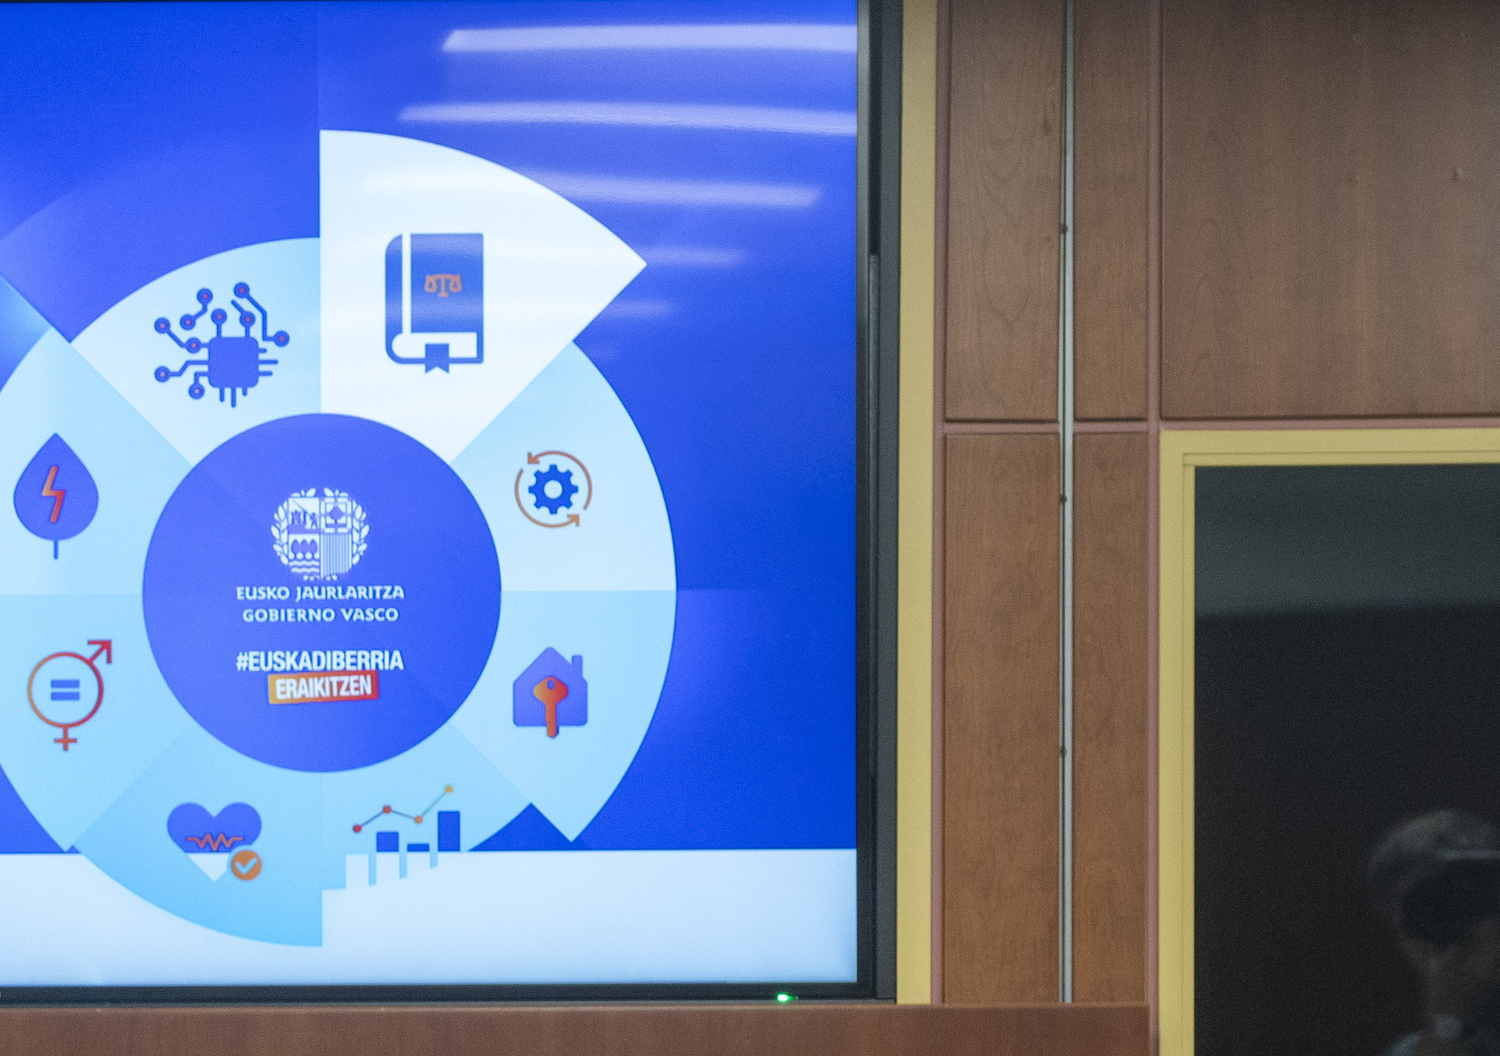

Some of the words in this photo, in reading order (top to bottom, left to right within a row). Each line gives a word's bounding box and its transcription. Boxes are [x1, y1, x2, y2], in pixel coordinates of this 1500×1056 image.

[236, 585, 290, 600] EUSKO
[295, 585, 405, 602] JAURLARITZA
[242, 608, 336, 623] GOBIERNO
[340, 607, 399, 622] VASCO
[236, 650, 404, 671] #EUSKADIBERRIA
[274, 674, 372, 700] ERAIKITZEN
